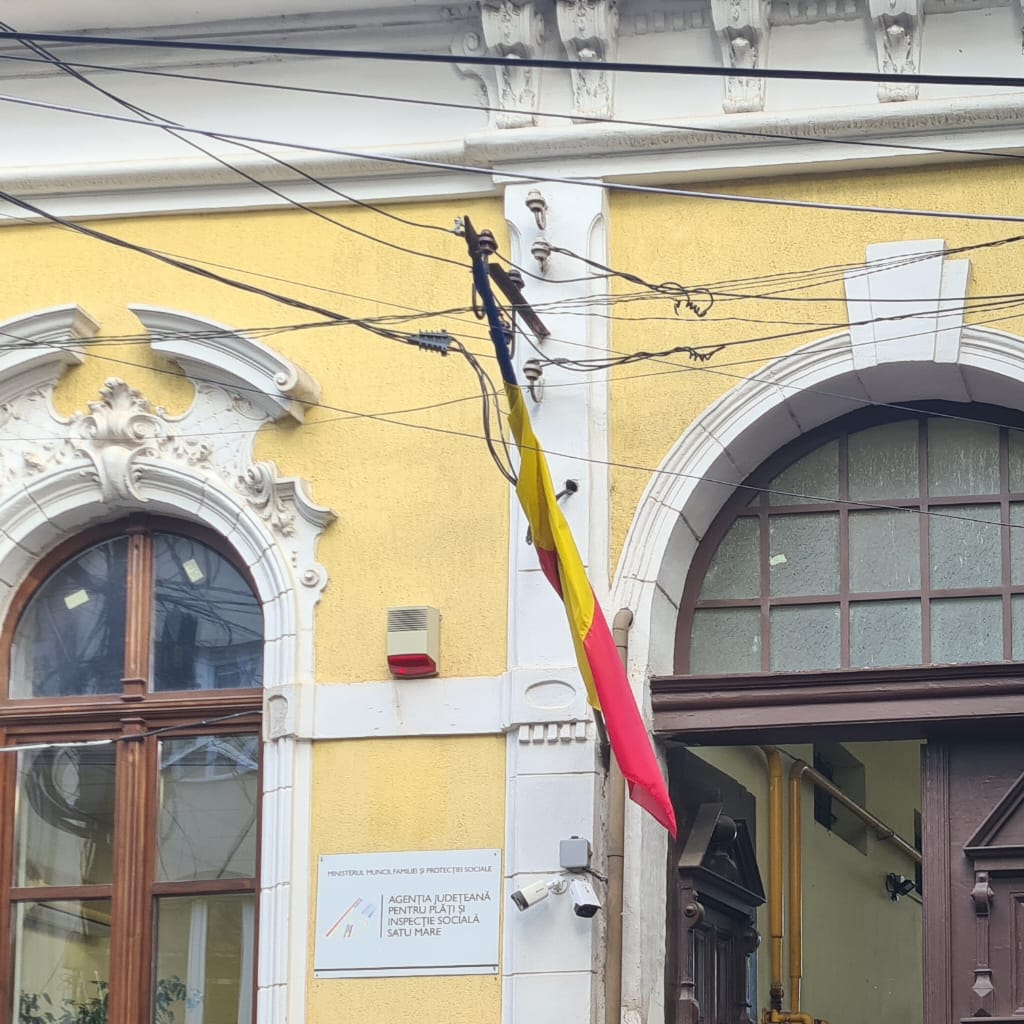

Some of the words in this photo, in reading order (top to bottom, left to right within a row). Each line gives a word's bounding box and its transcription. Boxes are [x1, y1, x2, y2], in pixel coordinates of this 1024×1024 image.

[388, 894, 432, 907] AGENȚIA
[433, 890, 491, 907] JUDEȚEANĂ
[388, 904, 426, 915] PENTRU
[429, 903, 456, 917] PLĂȚI
[458, 904, 466, 916] ȘI
[388, 916, 436, 929] INSPECȚIE
[437, 914, 480, 926] SOCIALĂ
[387, 928, 411, 938] SATU
[414, 927, 442, 937] MARE
